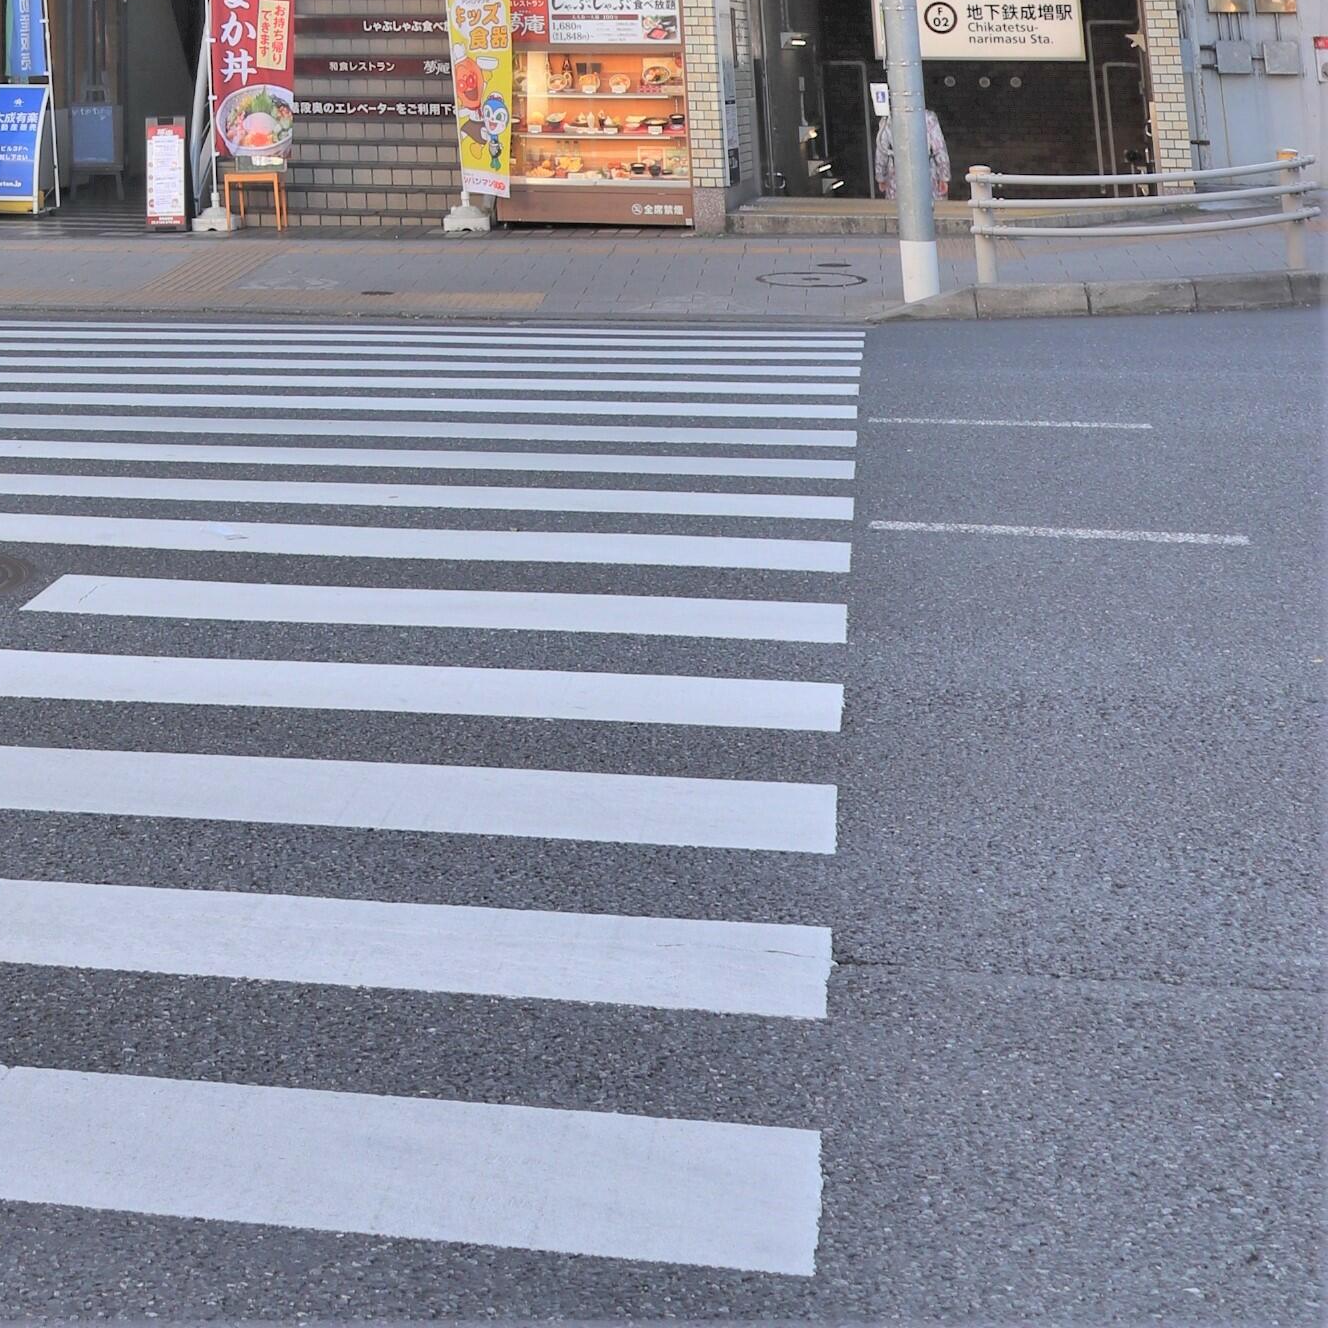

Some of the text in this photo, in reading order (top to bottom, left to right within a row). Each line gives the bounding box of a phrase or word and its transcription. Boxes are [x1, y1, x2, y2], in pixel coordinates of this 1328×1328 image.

[455, 1, 502, 28] キッズ
[937, 7, 943, 15] F
[966, 4, 1073, 21] 地下鉄成増駅
[933, 17, 950, 27] 02
[967, 21, 1039, 33] Chikatetsu-
[259, 9, 272, 57] できます
[272, 4, 286, 65] お持ち帰り
[469, 25, 509, 50] 食器
[968, 33, 1054, 44] narimasu Sta.
[328, 60, 396, 73] 和食レストラン
